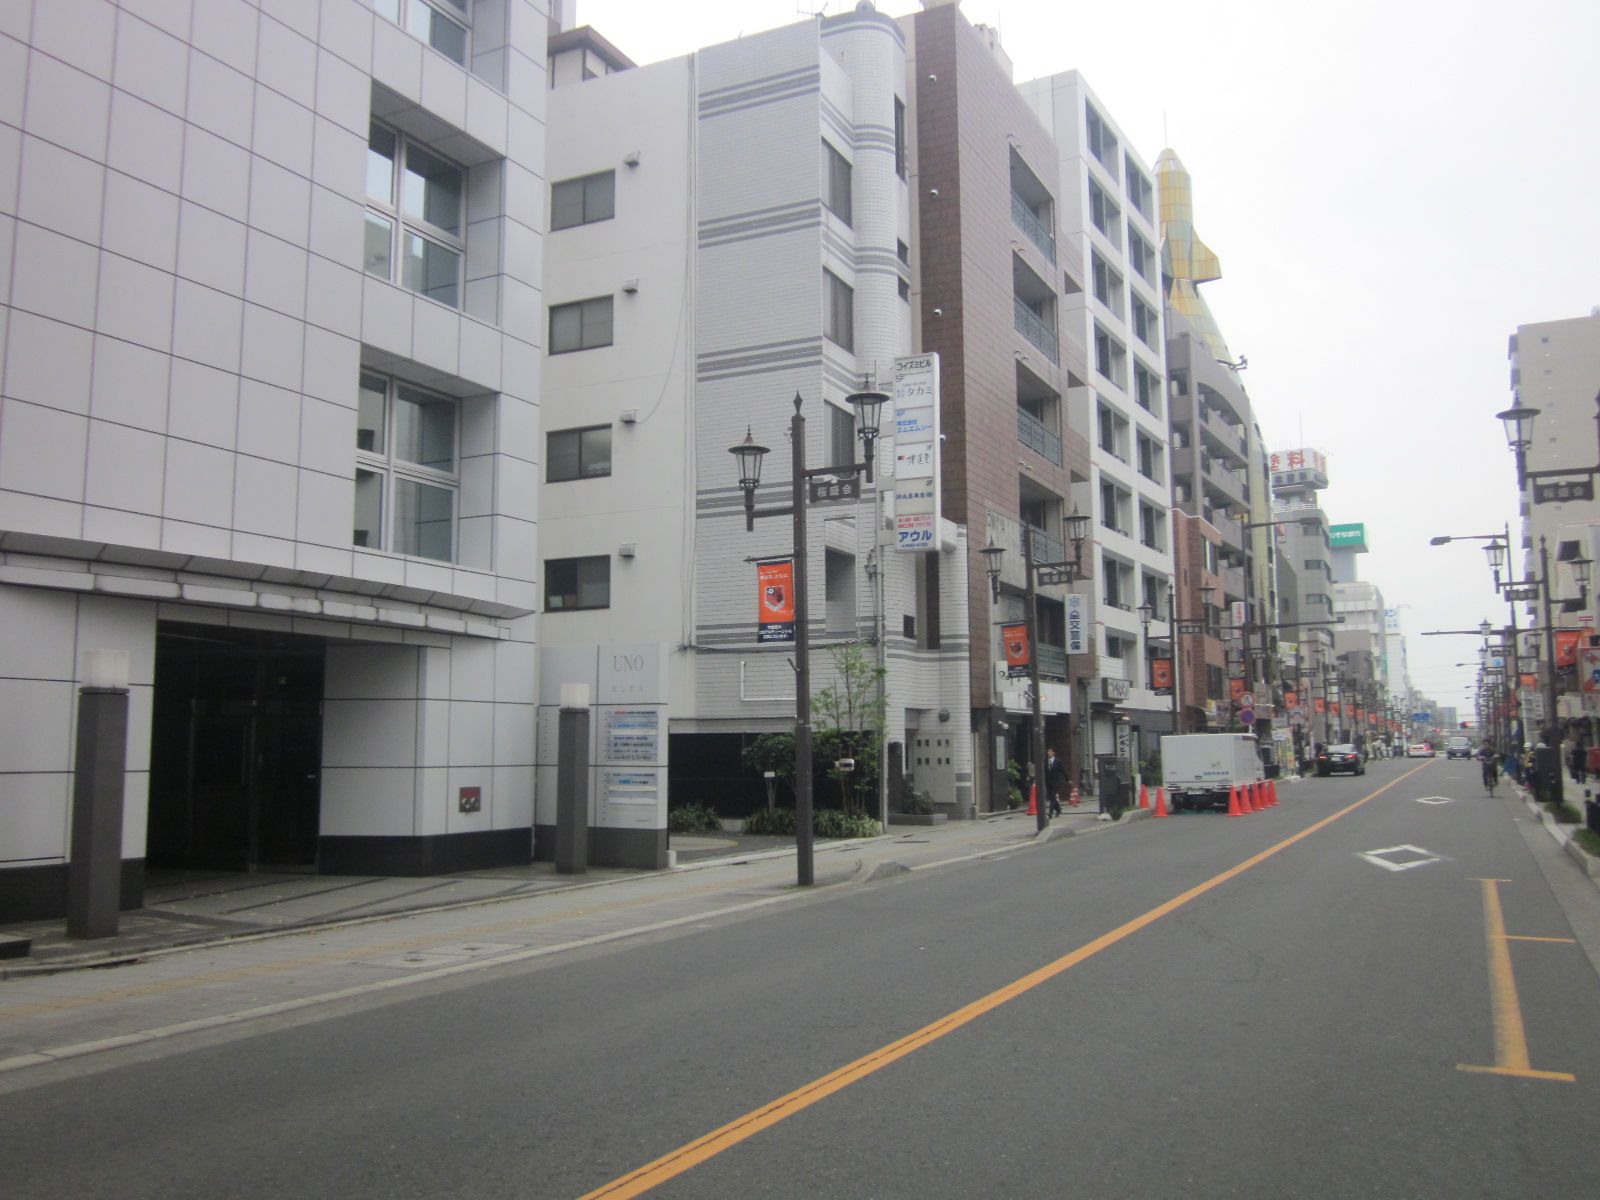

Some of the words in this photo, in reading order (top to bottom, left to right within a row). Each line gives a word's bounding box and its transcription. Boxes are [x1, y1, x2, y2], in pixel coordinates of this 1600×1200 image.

[896, 359, 931, 371] コイズミビル
[817, 484, 852, 498] 桜盛会
[898, 529, 932, 543] アウル
[613, 654, 644, 672] UNO
